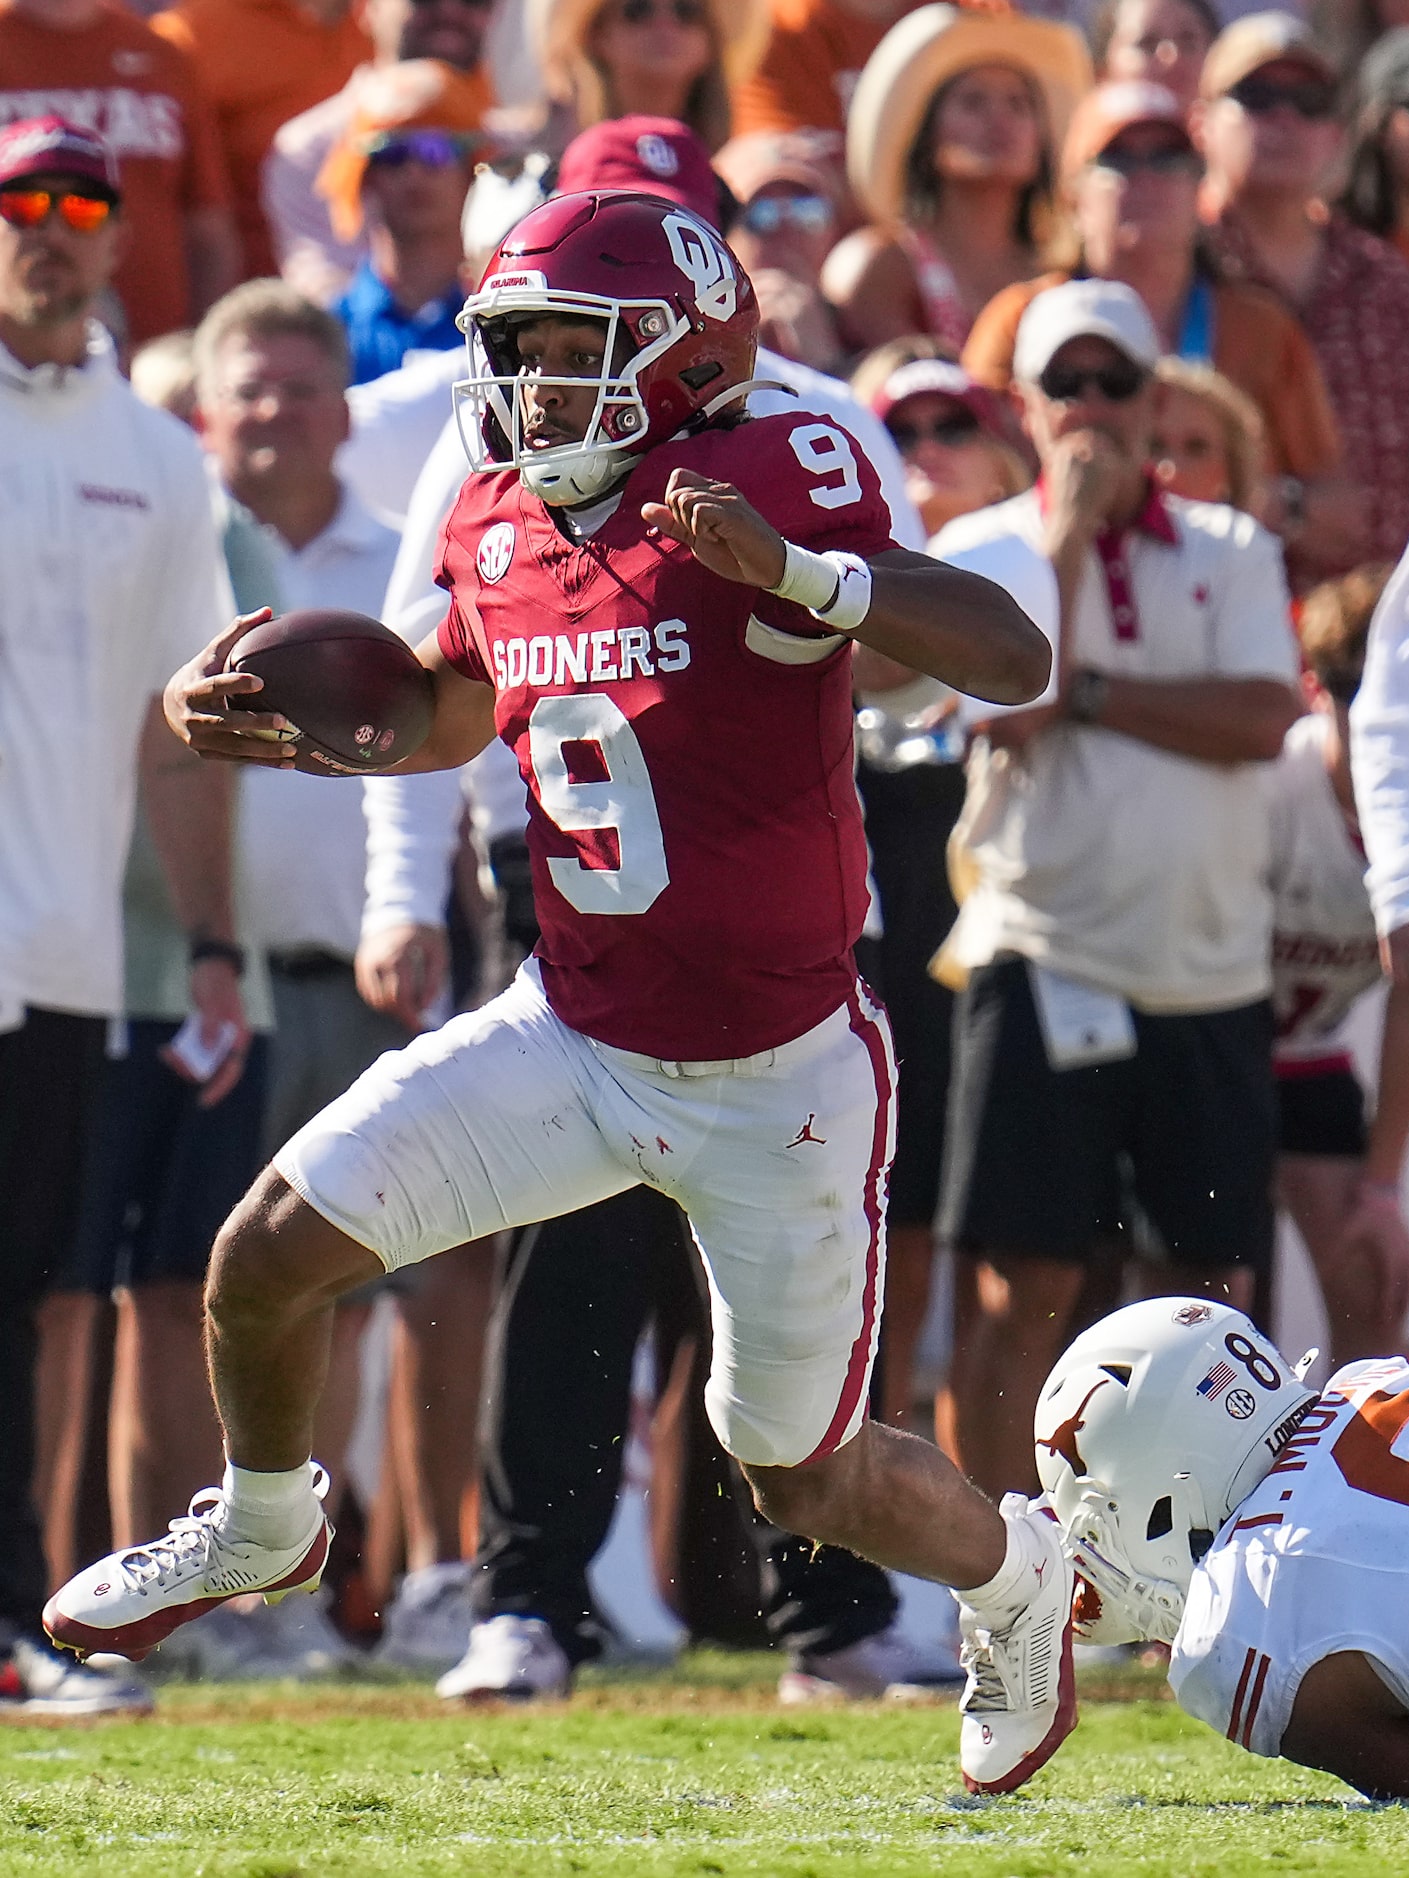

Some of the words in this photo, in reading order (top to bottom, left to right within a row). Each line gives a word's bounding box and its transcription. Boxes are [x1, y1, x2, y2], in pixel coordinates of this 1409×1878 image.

[661, 213, 738, 323] OU
[788, 423, 862, 510] 9
[480, 533, 511, 579] SEC
[493, 618, 691, 691] SOONERS
[529, 693, 670, 915] 9
[1225, 1333, 1281, 1391] 8
[1226, 1389, 1255, 1419] SEC
